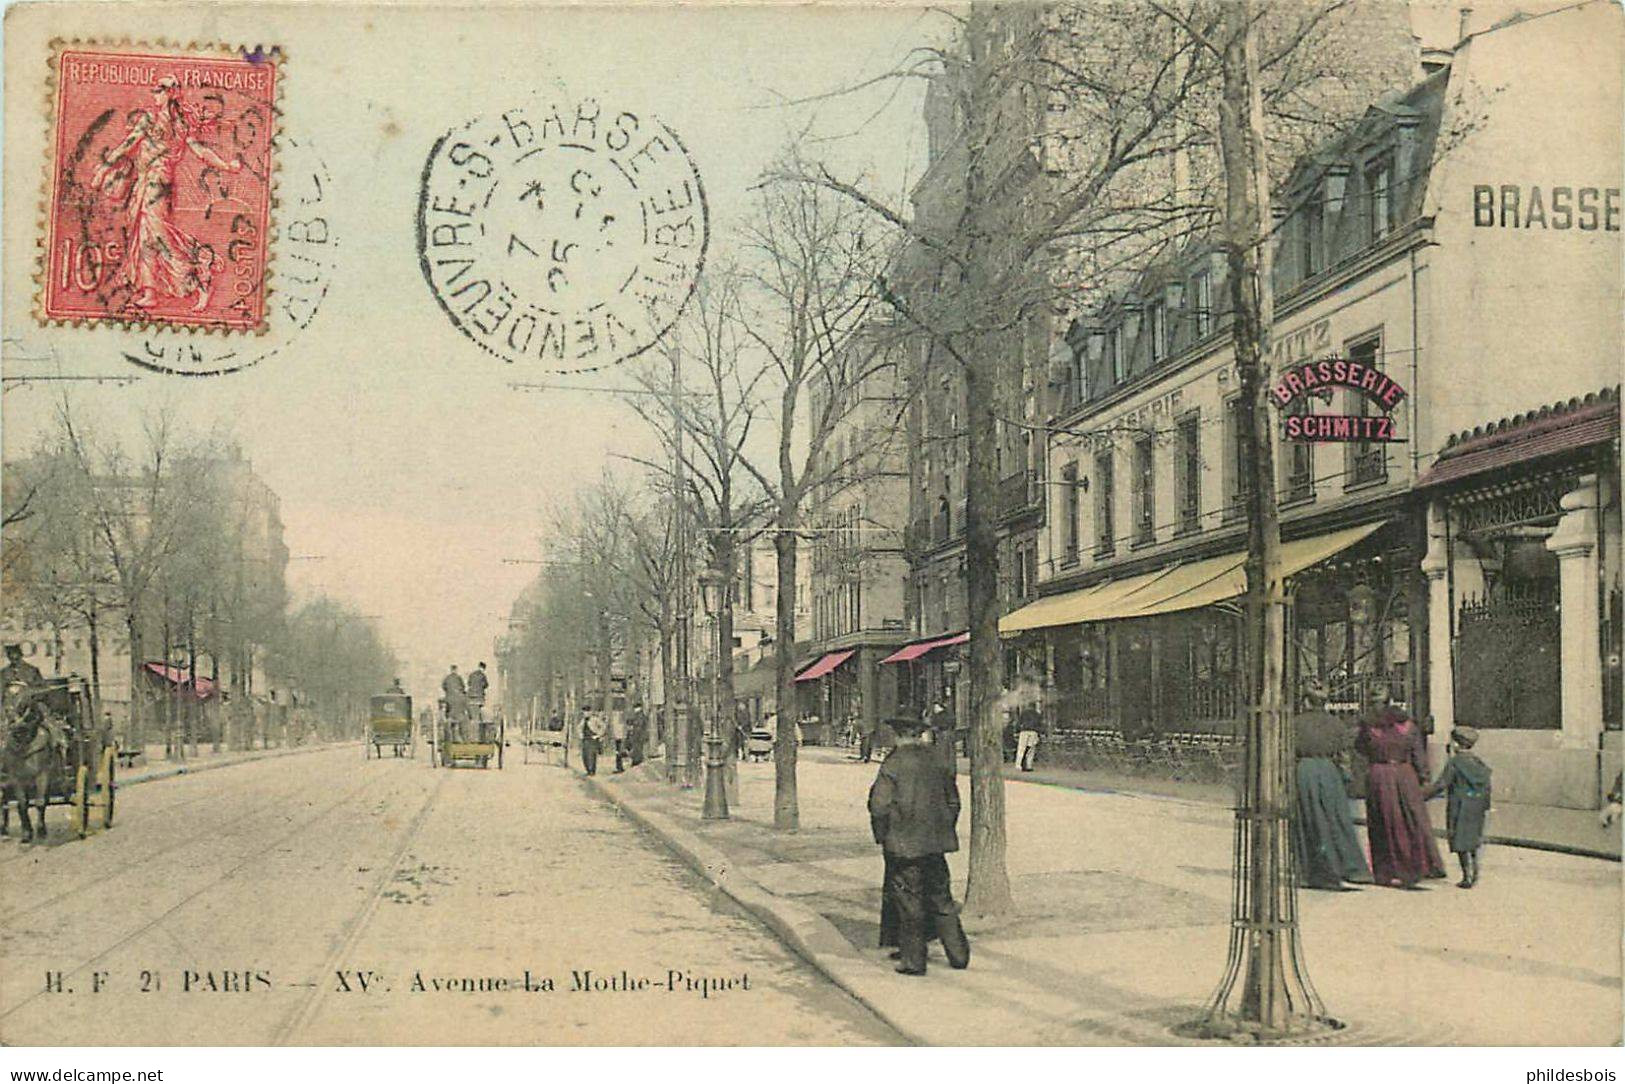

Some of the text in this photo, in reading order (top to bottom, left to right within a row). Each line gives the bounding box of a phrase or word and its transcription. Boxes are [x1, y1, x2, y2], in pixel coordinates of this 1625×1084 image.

[1473, 184, 1620, 231] BRASSE
[1274, 361, 1405, 405] BRASSERIE
[1286, 416, 1391, 438] SCHMITZ
